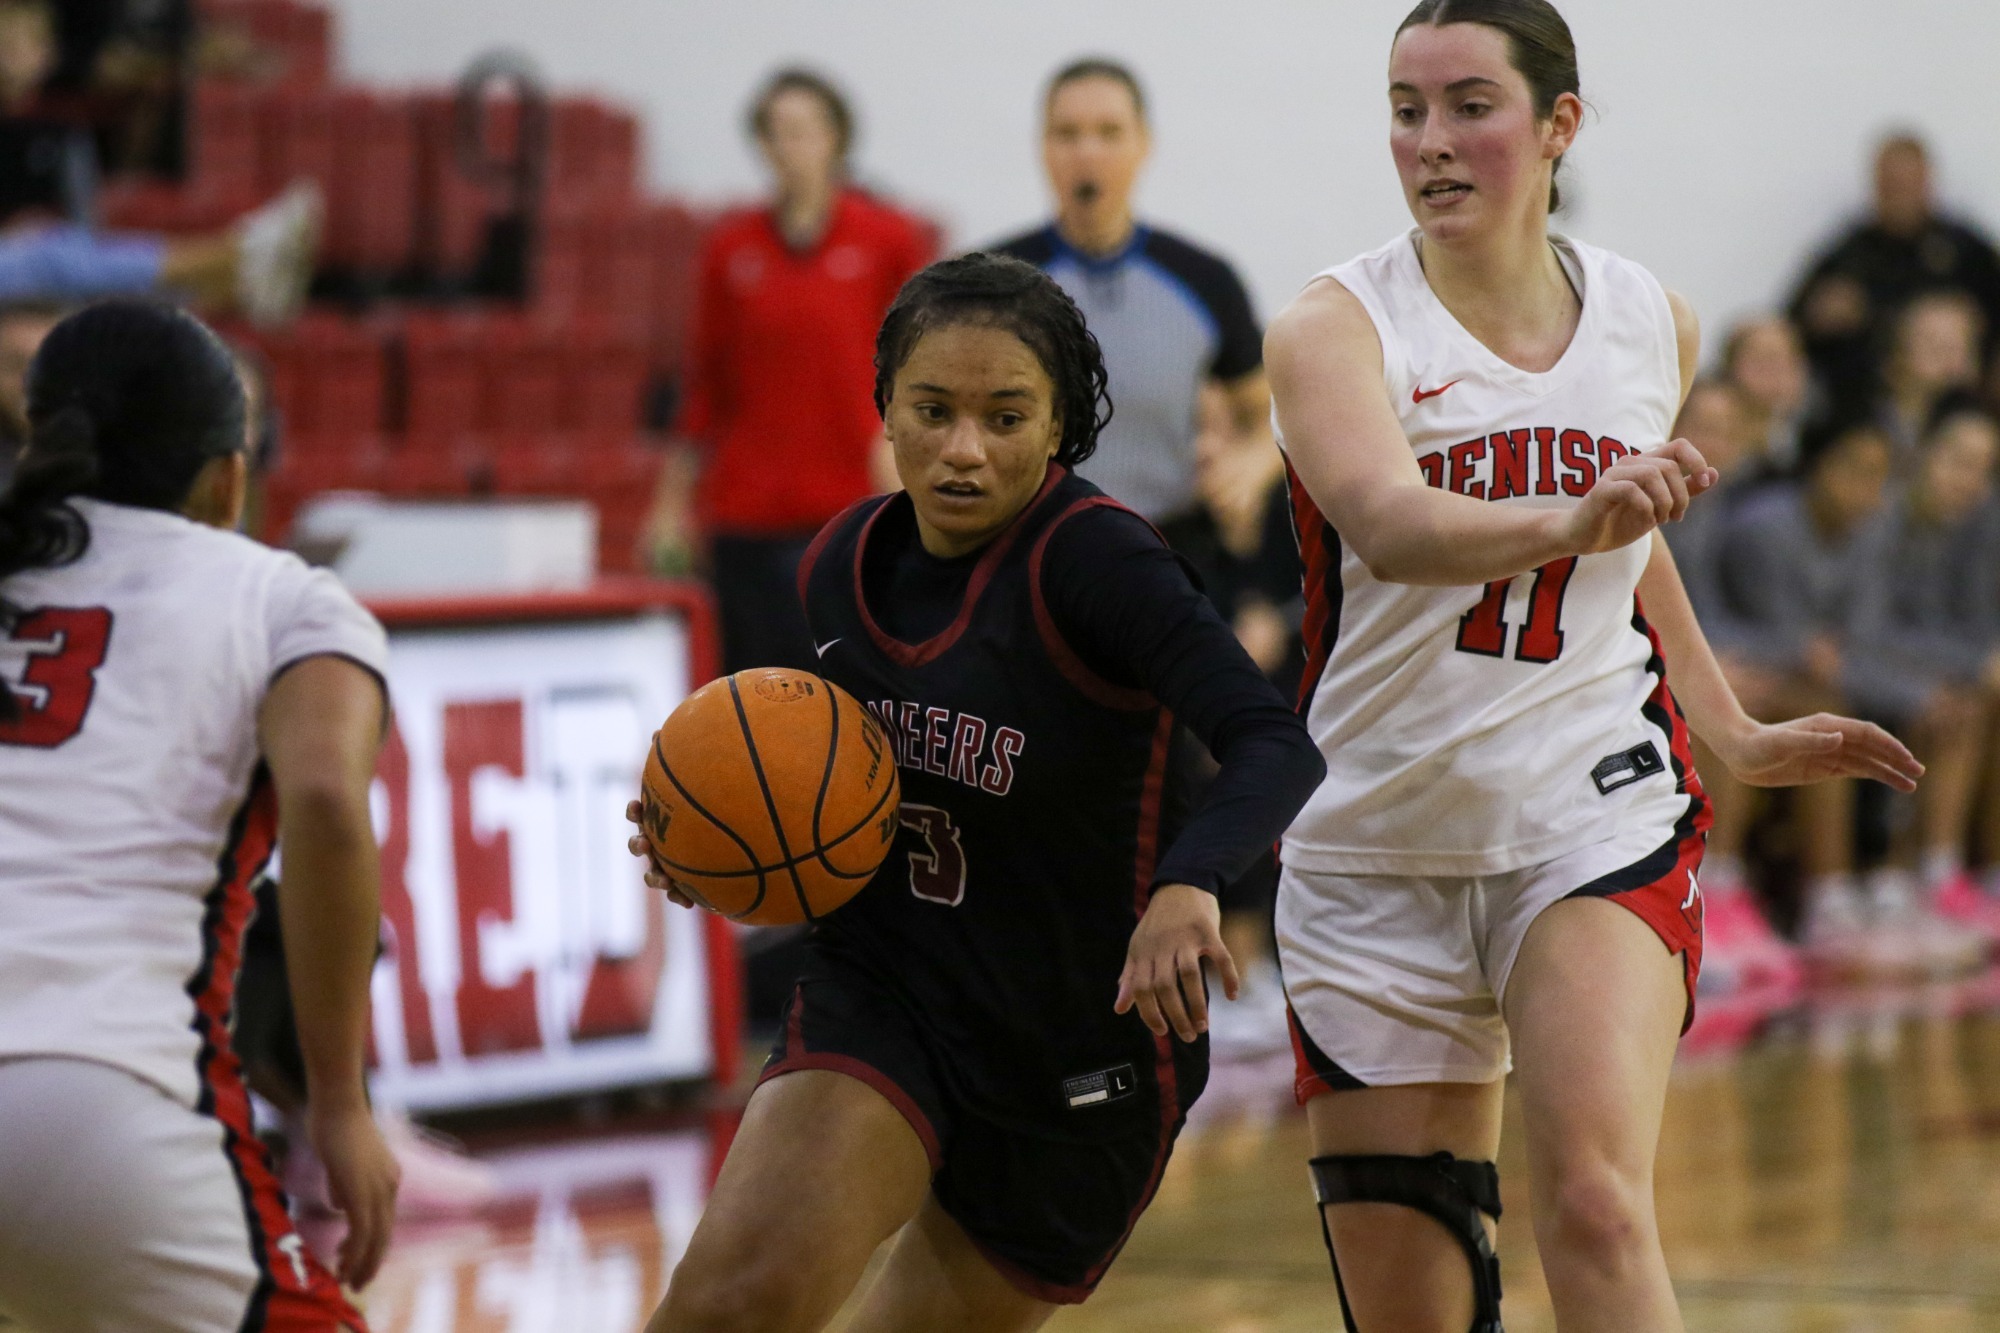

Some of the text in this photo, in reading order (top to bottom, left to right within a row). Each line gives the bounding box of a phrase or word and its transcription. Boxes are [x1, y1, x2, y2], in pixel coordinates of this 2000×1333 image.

[1455, 555, 1579, 665] 11
[1637, 754, 1652, 767] L
[899, 803, 967, 908] 3
[1115, 1076, 1127, 1091] L
